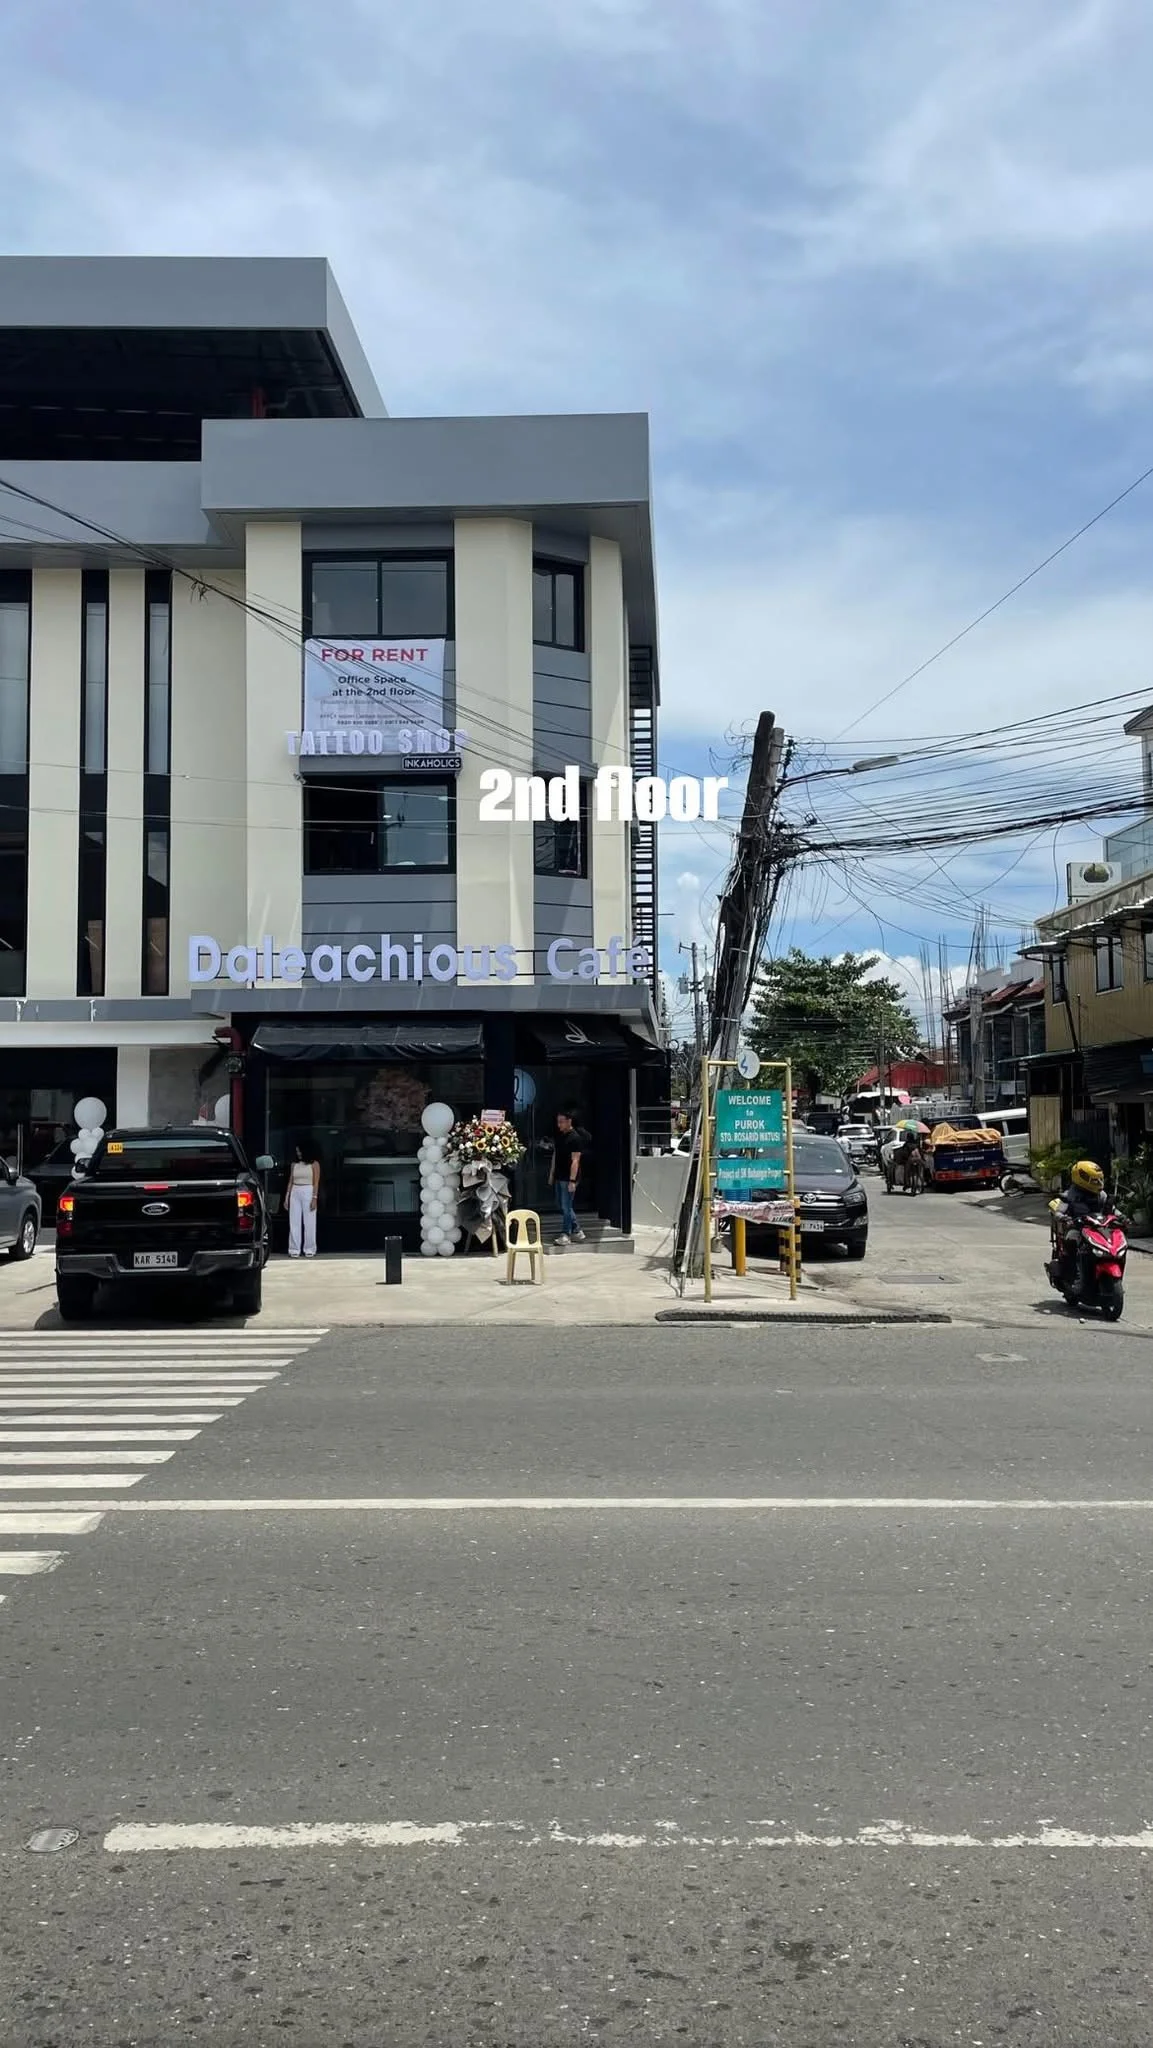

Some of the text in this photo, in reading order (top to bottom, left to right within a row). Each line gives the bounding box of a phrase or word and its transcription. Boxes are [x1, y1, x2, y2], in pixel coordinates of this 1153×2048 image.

[321, 649, 428, 661] FOR RENT
[338, 675, 406, 686] Office Space
[332, 686, 416, 697] at the 2nd floor
[284, 728, 469, 756] TATTOO SHOP
[404, 758, 461, 769] INKAHOLICS
[187, 933, 650, 983] Daleachious Café
[728, 1095, 771, 1106] WELCOME
[746, 1109, 754, 1117] to
[735, 1119, 765, 1130] PUROK
